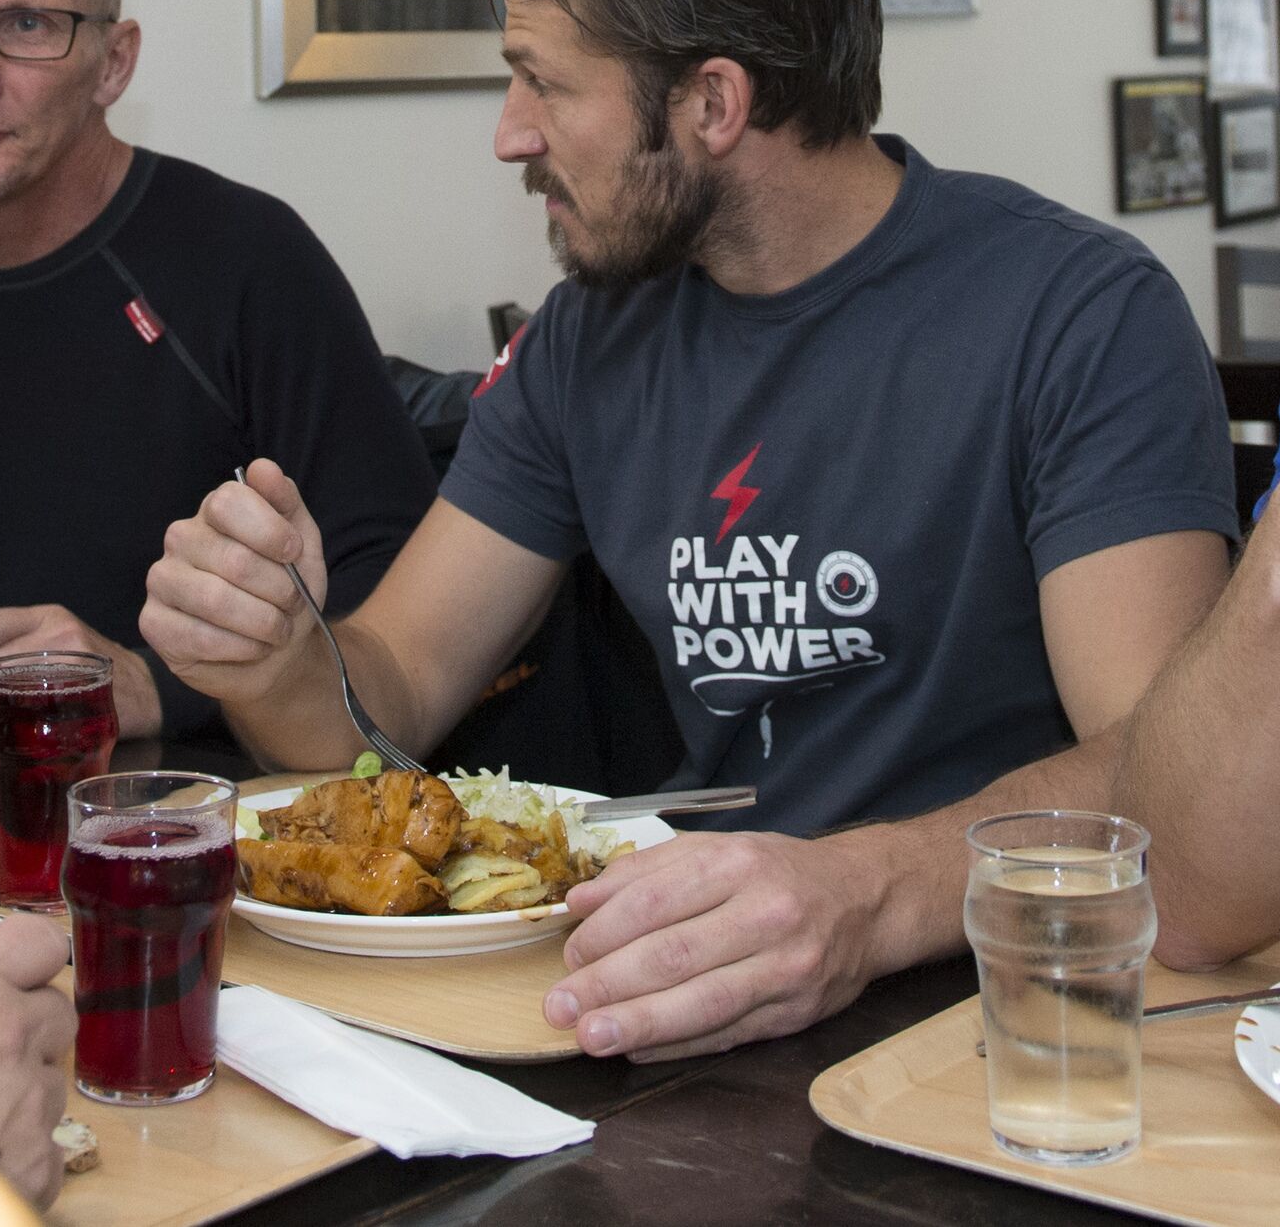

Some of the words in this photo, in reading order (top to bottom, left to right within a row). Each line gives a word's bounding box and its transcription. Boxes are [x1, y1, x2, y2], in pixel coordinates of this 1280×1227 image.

[670, 534, 800, 580] PLAY
[667, 580, 807, 626] WITH
[672, 625, 875, 672] POWER
